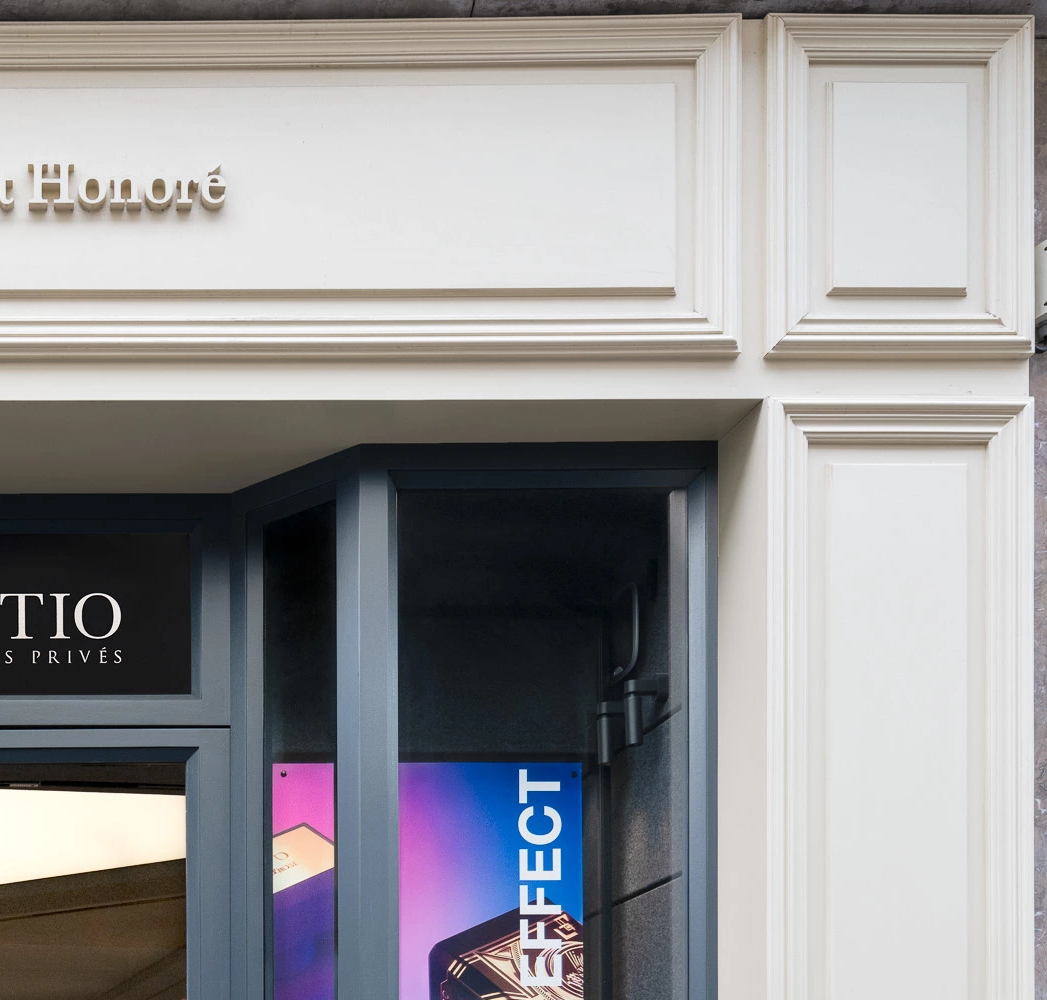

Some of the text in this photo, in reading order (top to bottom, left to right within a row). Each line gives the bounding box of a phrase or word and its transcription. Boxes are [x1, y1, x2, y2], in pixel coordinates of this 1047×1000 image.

[28, 162, 228, 211] Honoré
[32, 647, 123, 665] PRIVÉS
[518, 768, 563, 986] EFFECT
